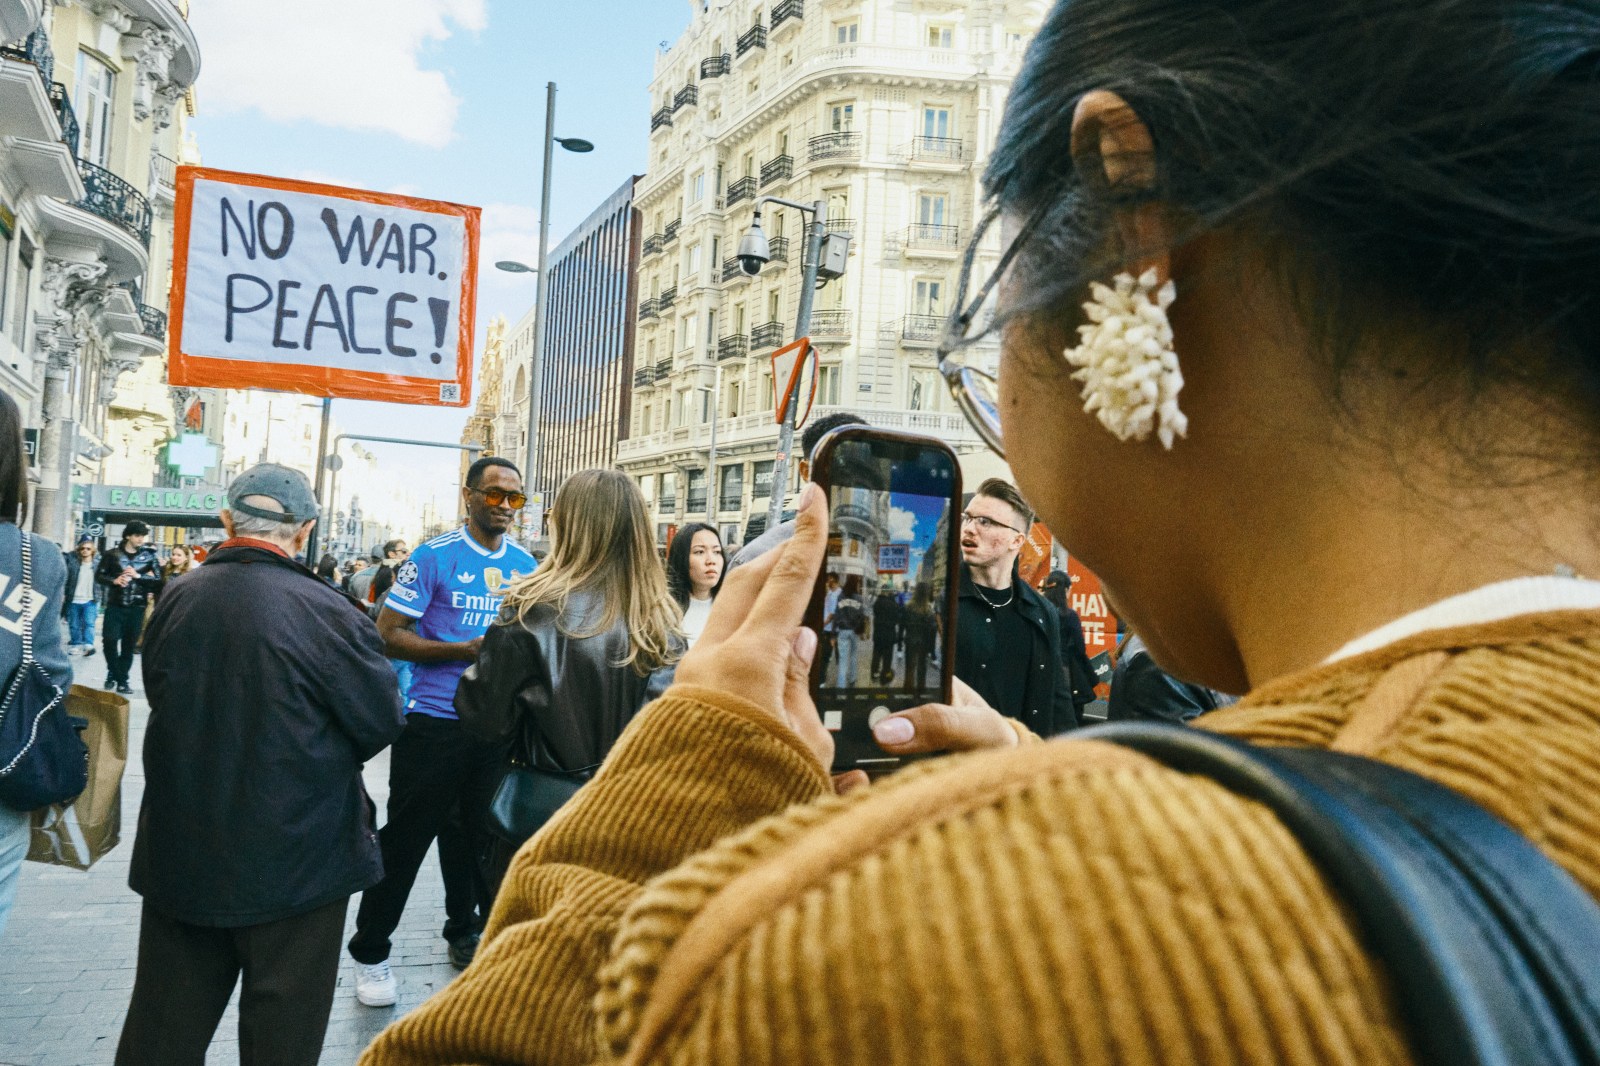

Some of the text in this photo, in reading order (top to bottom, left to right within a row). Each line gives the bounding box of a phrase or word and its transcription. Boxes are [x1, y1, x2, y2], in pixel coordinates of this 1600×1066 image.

[220, 196, 448, 281] NO WAR.
[224, 272, 450, 365] PEACE!
[461, 611, 482, 626] FLY
